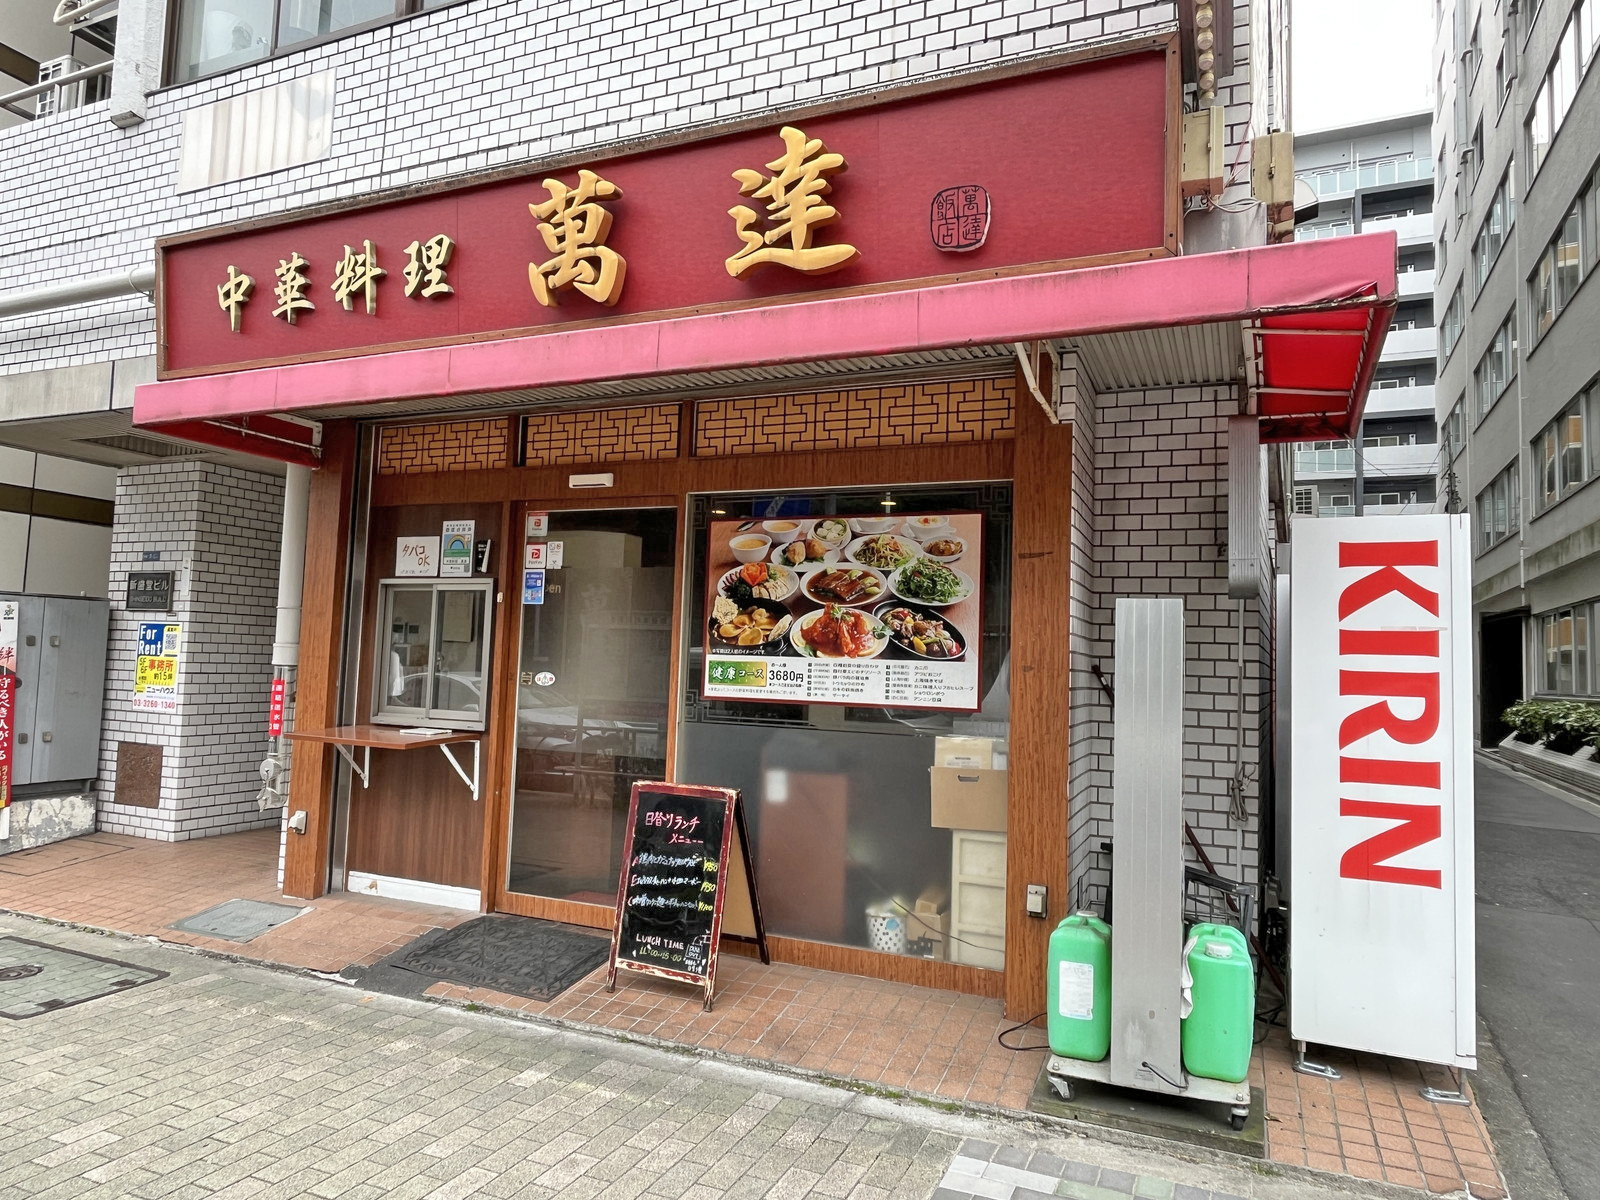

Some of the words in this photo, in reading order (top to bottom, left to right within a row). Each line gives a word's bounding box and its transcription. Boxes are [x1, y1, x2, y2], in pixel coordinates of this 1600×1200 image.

[217, 234, 454, 332] 中華料理
[402, 544, 426, 557] タバコ
[417, 555, 431, 566] OK
[140, 625, 158, 640] For
[138, 641, 162, 655] Rent
[149, 659, 174, 672] 事務所
[712, 665, 765, 680] 健康コース
[768, 669, 804, 683] 3680円
[146, 686, 175, 694] ニューハウス
[1338, 540, 1442, 889] KIRIN
[636, 933, 662, 947] LUNCH
[663, 938, 685, 950] TIME
